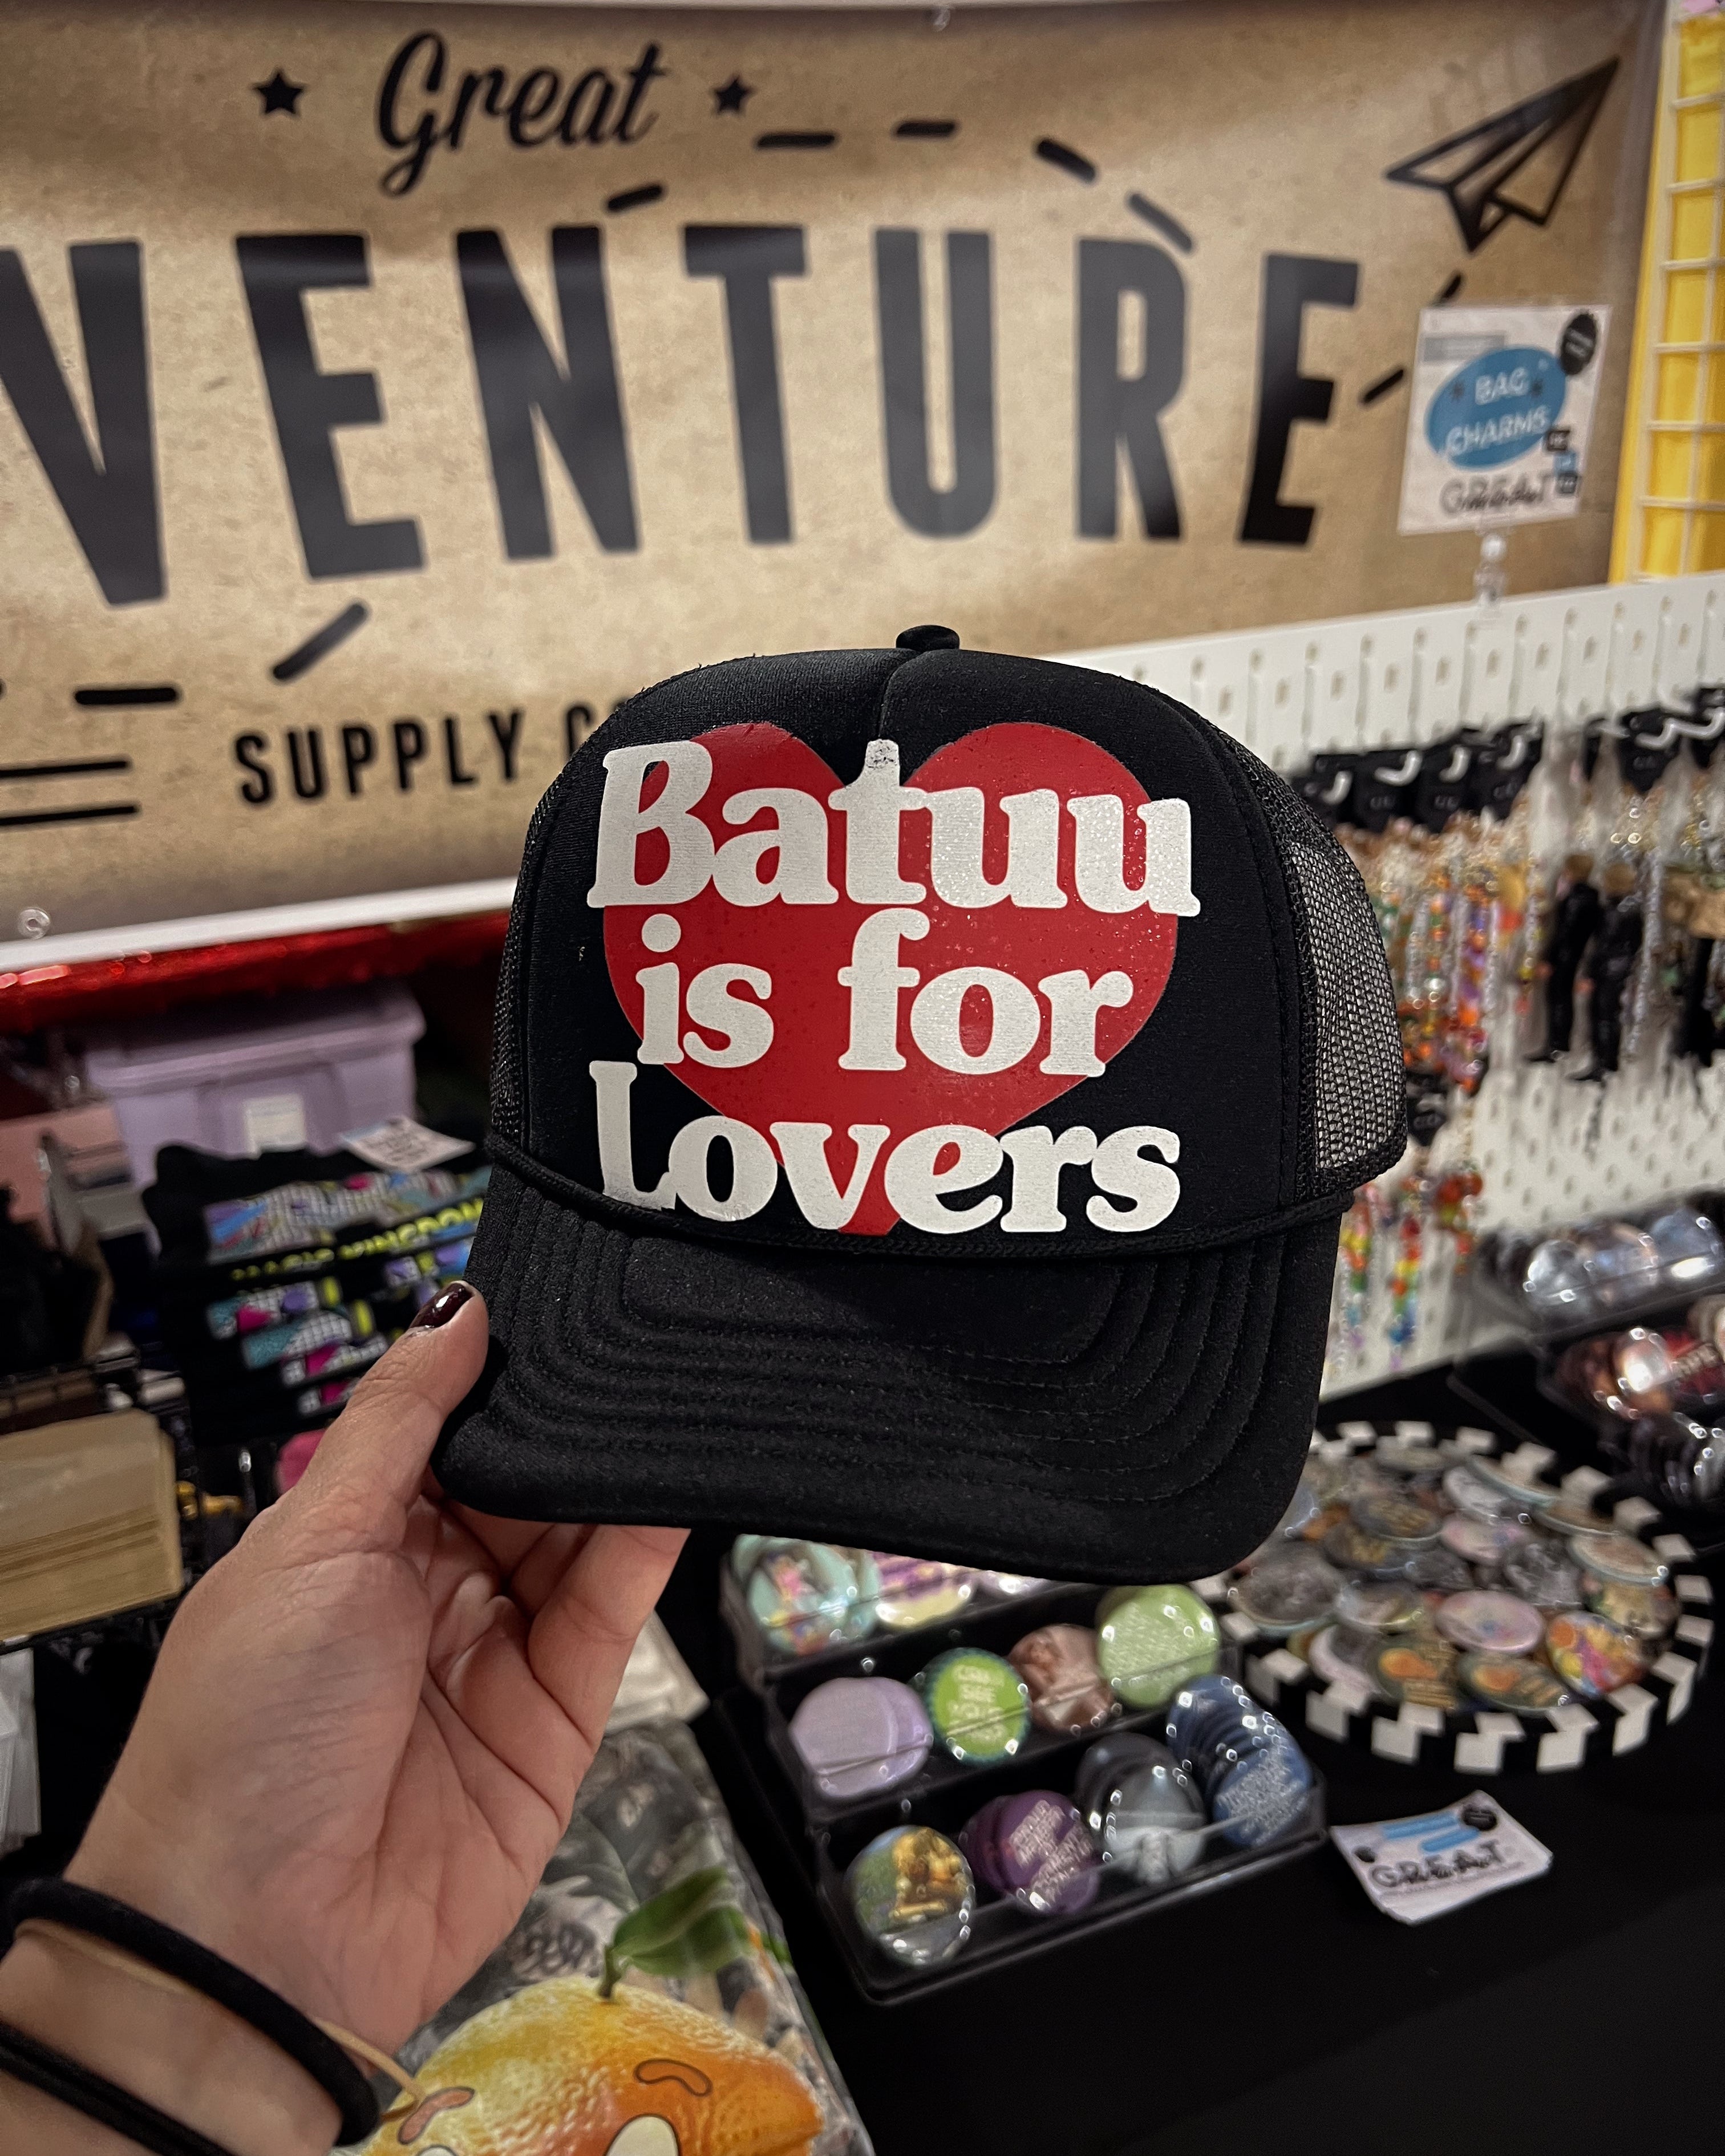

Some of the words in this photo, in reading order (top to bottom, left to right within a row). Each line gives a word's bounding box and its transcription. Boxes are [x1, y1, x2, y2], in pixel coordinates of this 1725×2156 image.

[377, 30, 669, 198] Great
[1445, 406, 1549, 456] CHARMS
[1475, 366, 1531, 406] BAG
[234, 710, 524, 804] SUPPLY
[586, 740, 1201, 916] Batuu
[635, 913, 775, 1068] is
[837, 907, 1134, 1077] for
[588, 1060, 1181, 1234] Lovers
